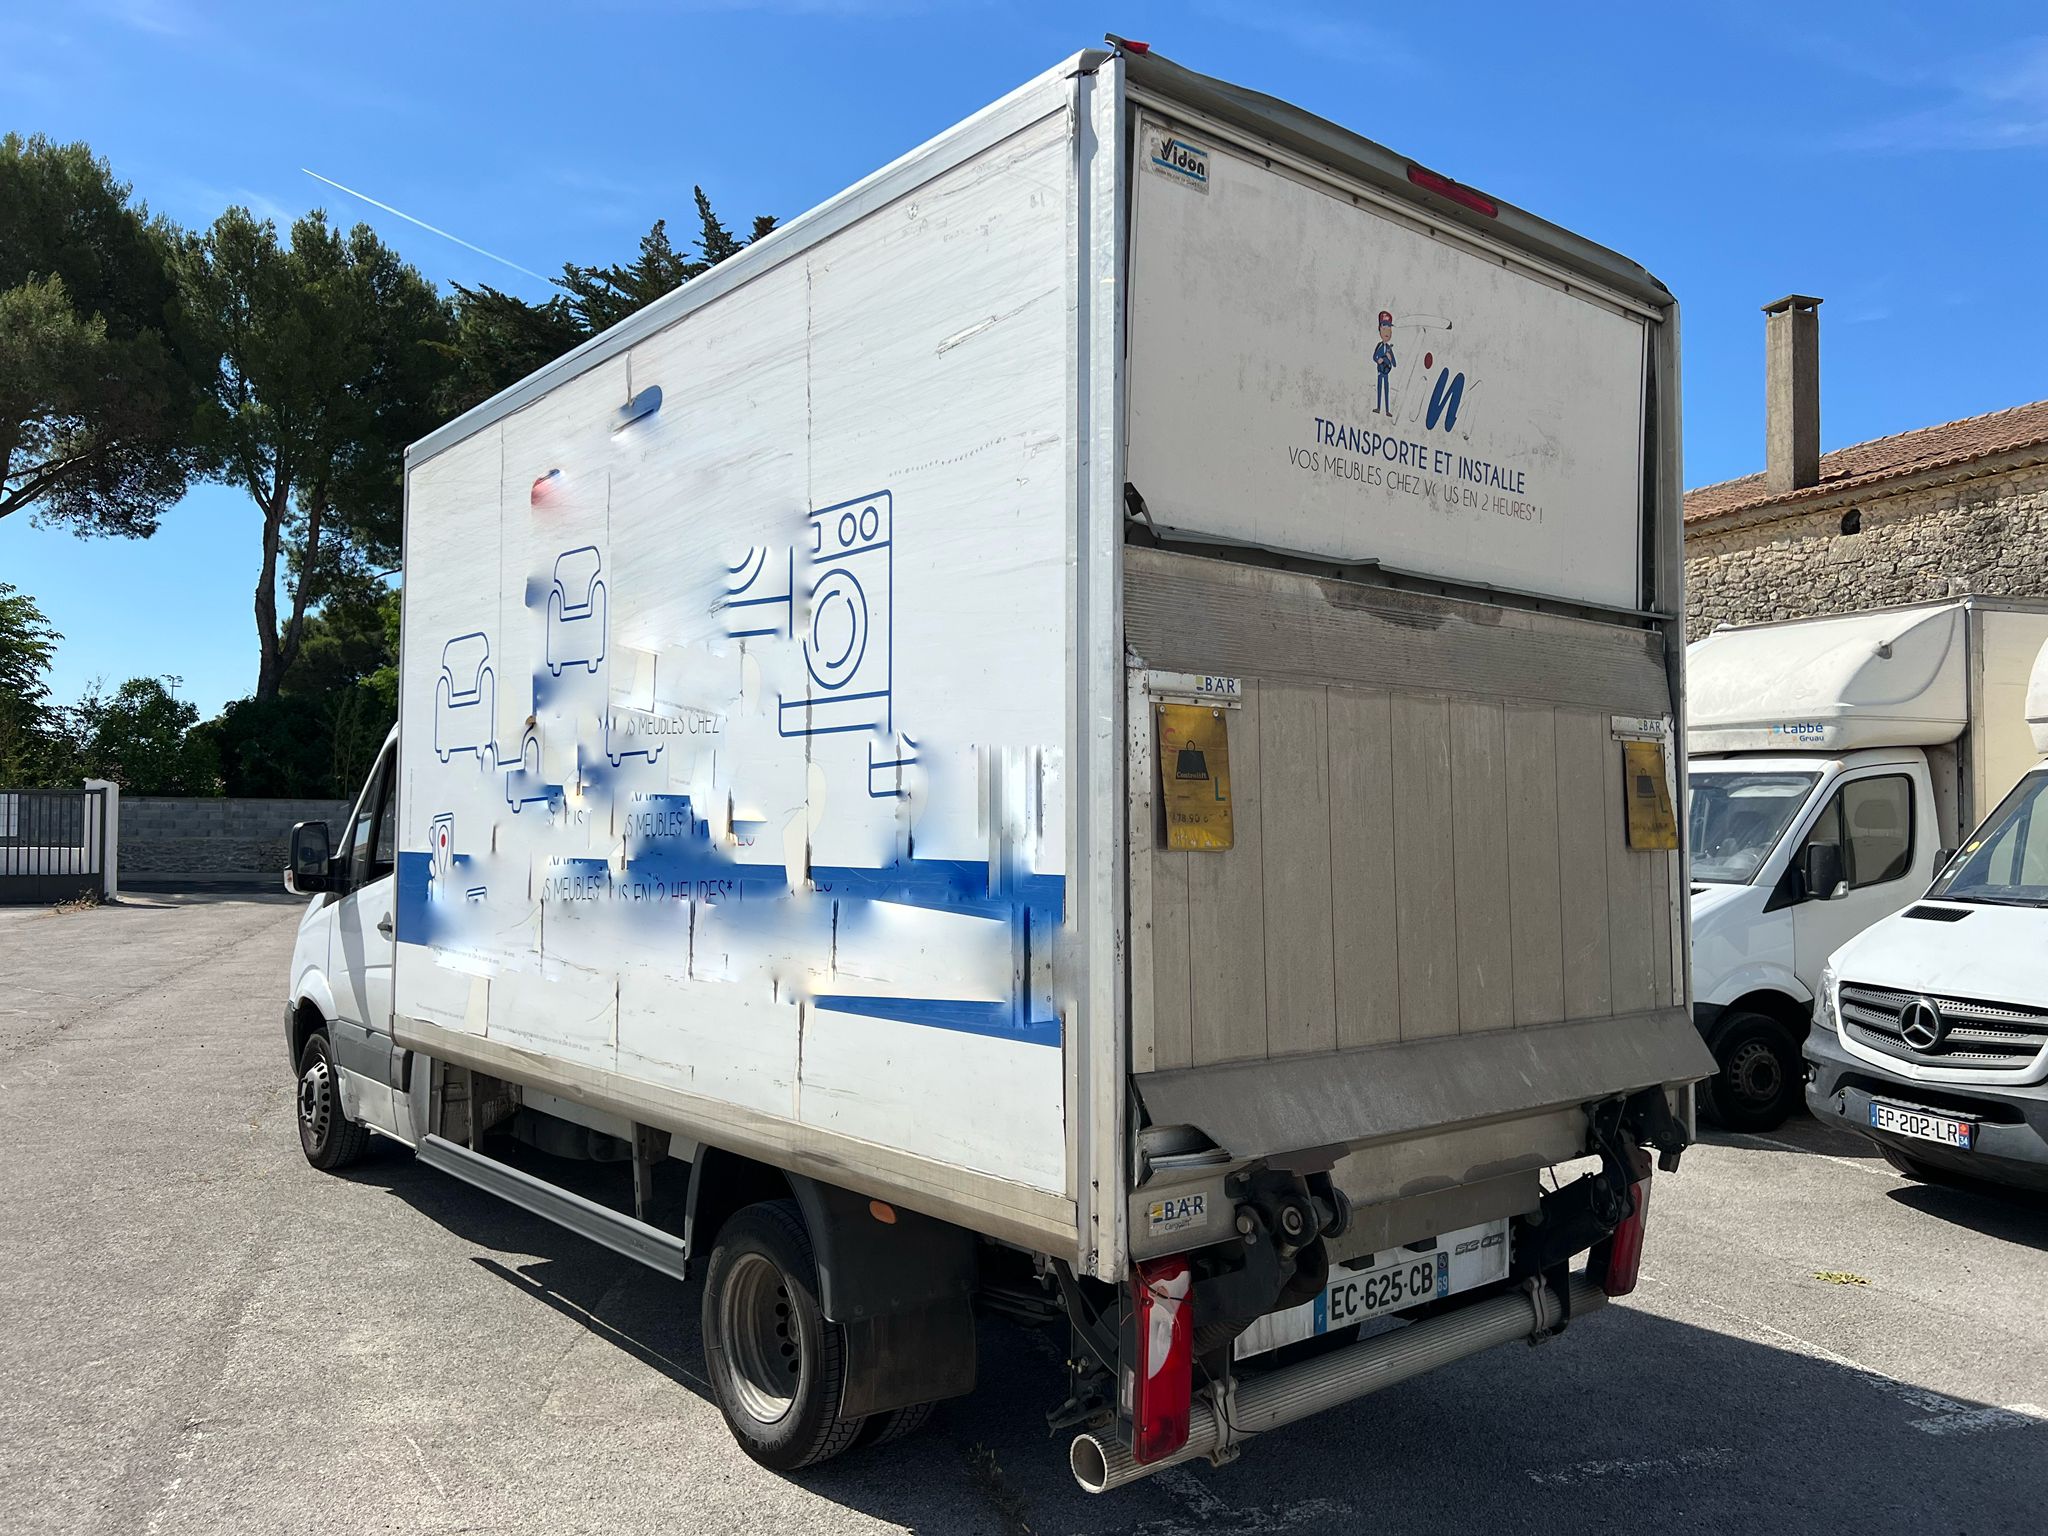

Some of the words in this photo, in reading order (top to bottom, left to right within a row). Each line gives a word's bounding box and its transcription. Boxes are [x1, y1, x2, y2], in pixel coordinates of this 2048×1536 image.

[1160, 137, 1205, 176] Vidon
[1315, 417, 1428, 470] TRANSPORTE
[1434, 449, 1453, 476] ET
[1458, 455, 1525, 495] INSTALLE
[1288, 445, 1320, 472] VOS
[1324, 455, 1382, 486] MEUBLES
[1386, 470, 1420, 496] CHEZ
[1463, 488, 1478, 508] EN
[1481, 493, 1489, 511] 2
[1205, 676, 1235, 694] BÄR
[1783, 722, 1824, 734] Labbé
[1877, 1108, 1957, 1142] EP-202-LR
[1960, 1136, 1968, 1145] 34
[1165, 1196, 1203, 1219] BÄR
[1437, 1277, 1448, 1293] 69
